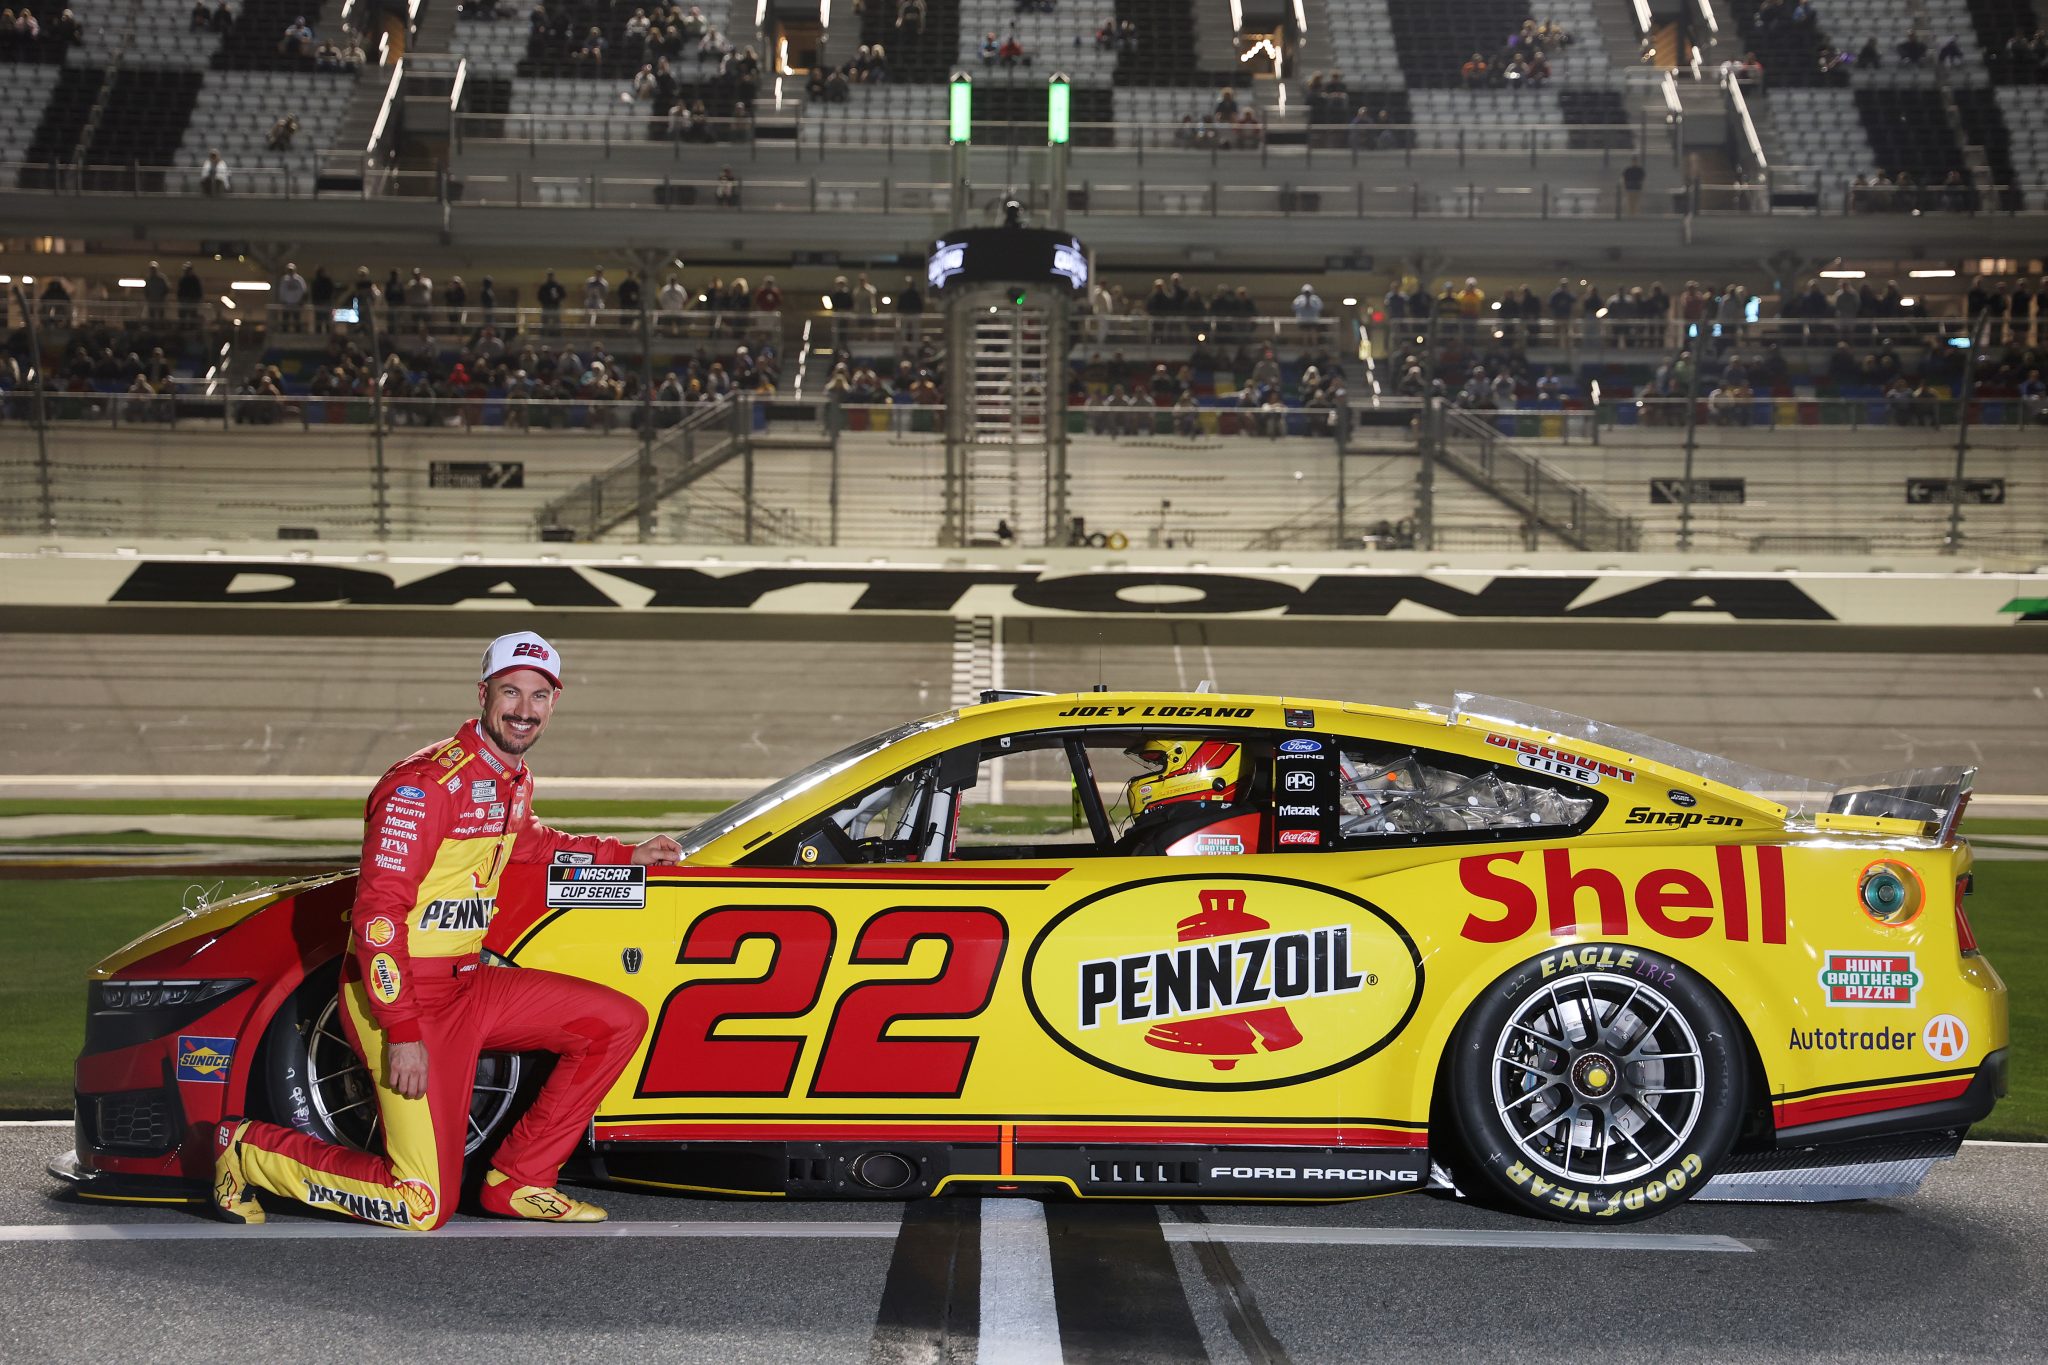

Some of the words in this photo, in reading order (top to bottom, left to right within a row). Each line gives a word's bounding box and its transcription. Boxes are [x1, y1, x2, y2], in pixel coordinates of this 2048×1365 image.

[107, 561, 1837, 620] DAYTONA
[512, 642, 544, 659] 22
[1058, 706, 1136, 717] JOEY
[1141, 706, 1255, 718] LOGANO
[478, 747, 505, 774] PENNZOIL
[1486, 733, 1634, 783] DISCOUNT
[1526, 755, 1590, 781] TIRE
[1287, 773, 1313, 789] PPG
[391, 796, 425, 807] RACING
[1279, 805, 1320, 816] Mazak
[1625, 807, 1743, 828] Snap-on
[385, 815, 417, 831] Mazak
[380, 827, 418, 841] SIEMENS
[375, 853, 402, 864] planet
[376, 860, 407, 872] fitness
[579, 868, 631, 881] NASCAR
[560, 887, 586, 898] CUP
[587, 887, 631, 898] SERIES
[1459, 845, 1787, 944] Shell
[1540, 947, 1639, 979] EAGLE
[1846, 959, 1893, 972] HUNT
[375, 959, 395, 997] PENNZOIL
[1080, 925, 1363, 1028] PENNZOIL
[1827, 972, 1913, 986] BROTHERS
[1846, 987, 1895, 999] PIZZA
[633, 904, 1010, 1099] 22
[1789, 1026, 1916, 1050] Autotrader
[181, 1054, 231, 1067] SUNOCO
[219, 1126, 230, 1147] 22
[1211, 1167, 1296, 1180] FORD
[1303, 1168, 1418, 1182] RACING
